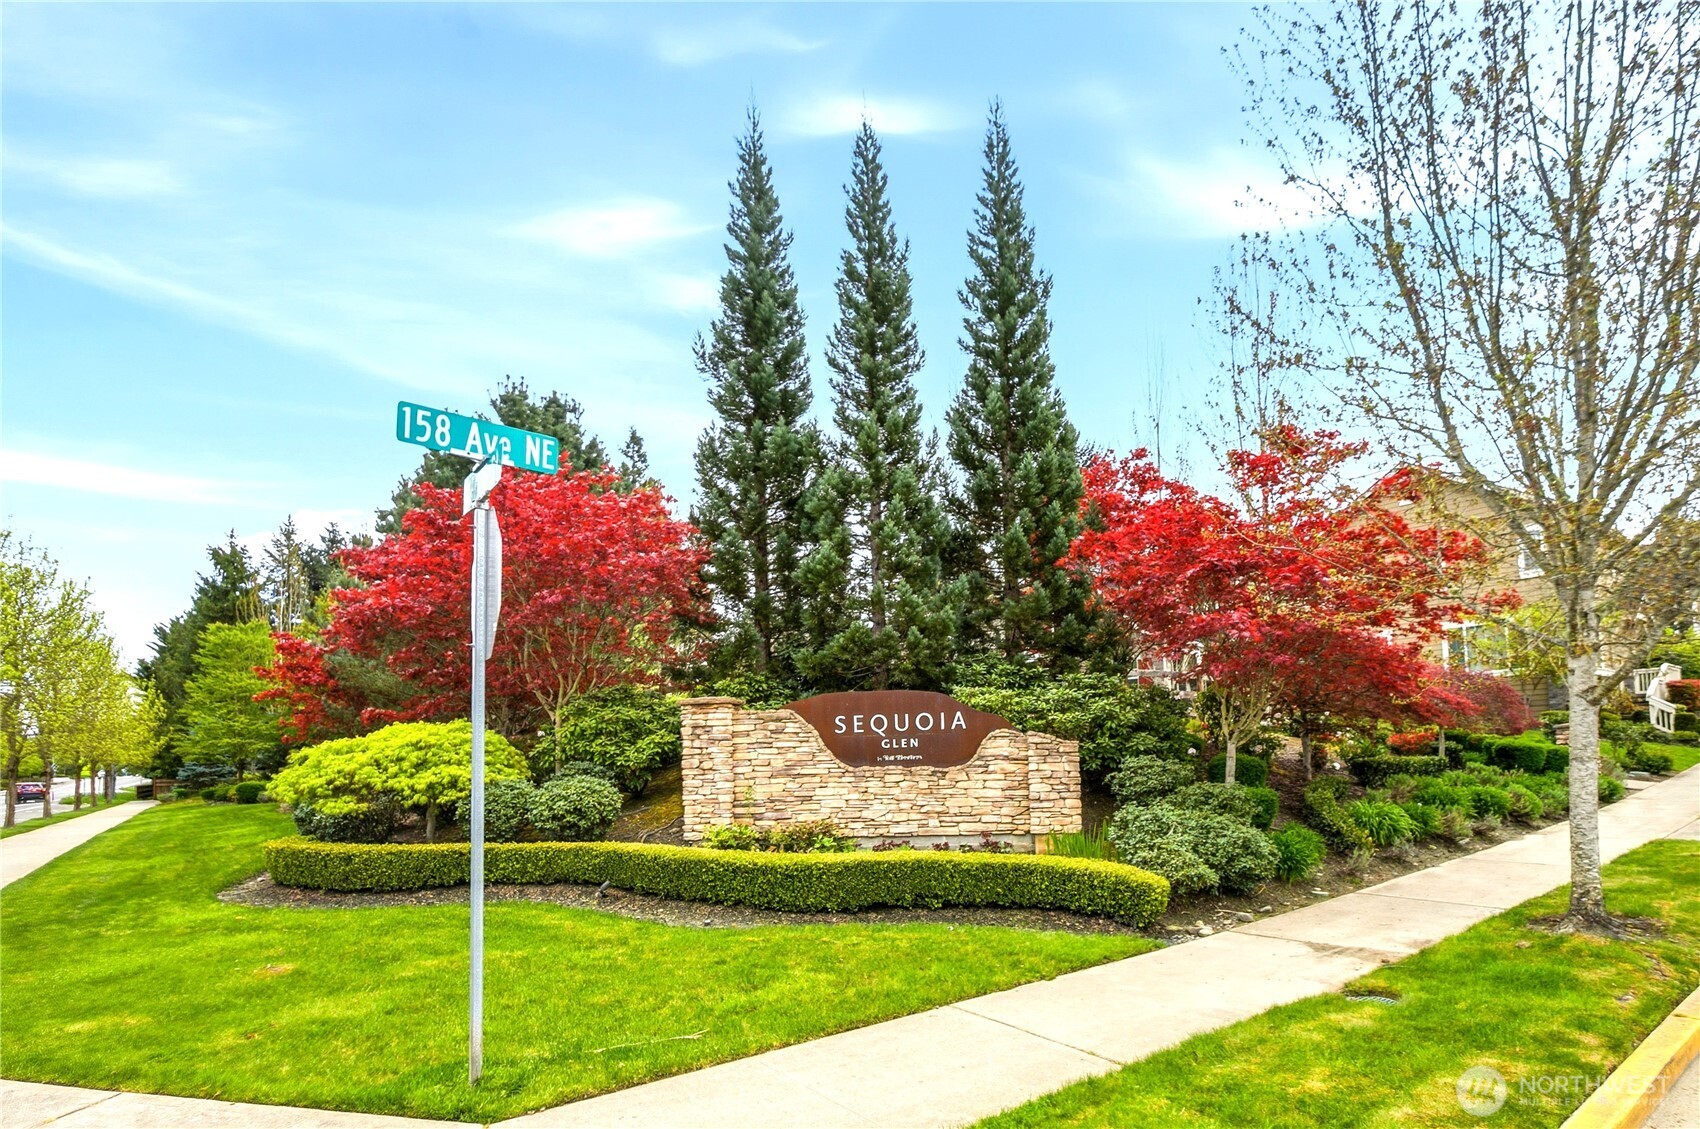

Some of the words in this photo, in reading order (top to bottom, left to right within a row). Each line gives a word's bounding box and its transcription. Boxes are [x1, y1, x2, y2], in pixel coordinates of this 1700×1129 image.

[402, 406, 451, 447] 158
[464, 421, 512, 460] Ave
[525, 435, 555, 470] NE
[834, 711, 967, 737] SEQUOIA
[881, 738, 919, 749] GLEN
